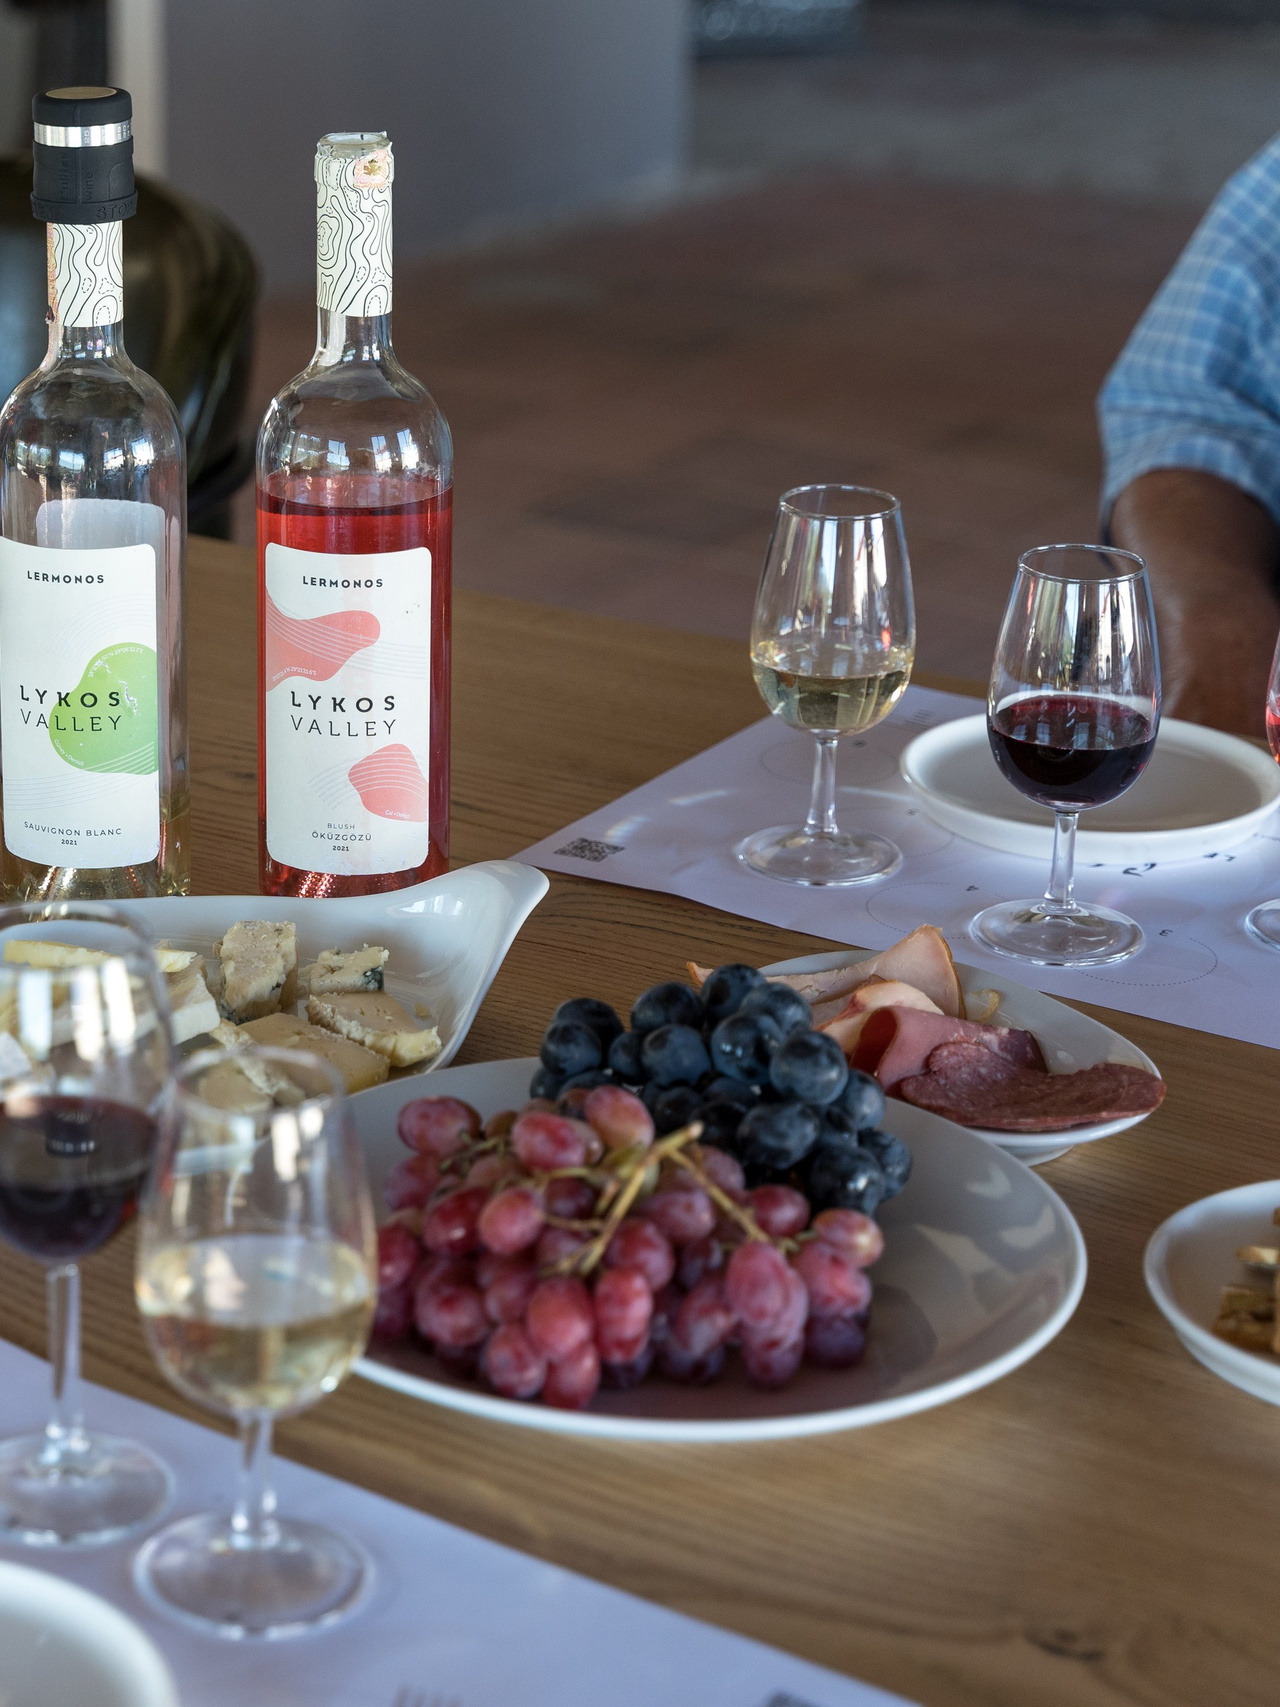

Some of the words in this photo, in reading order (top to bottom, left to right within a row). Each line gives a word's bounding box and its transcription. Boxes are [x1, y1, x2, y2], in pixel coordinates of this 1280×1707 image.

[83, 171, 94, 201] wine
[95, 200, 133, 221] STOP
[27, 570, 104, 584] LERMONOS
[302, 575, 383, 589] LERMONOS
[19, 684, 120, 708] LYKOS
[290, 690, 395, 713] LYKOS
[20, 708, 121, 732] VALLEY
[290, 714, 396, 737] VALLEY
[24, 821, 81, 836] SAUVIGNON
[86, 828, 122, 836] BLANC
[327, 822, 356, 830] BLUSH
[311, 831, 372, 842] ÖKÜZGÖZÜ
[1159, 929, 1174, 938] 3
